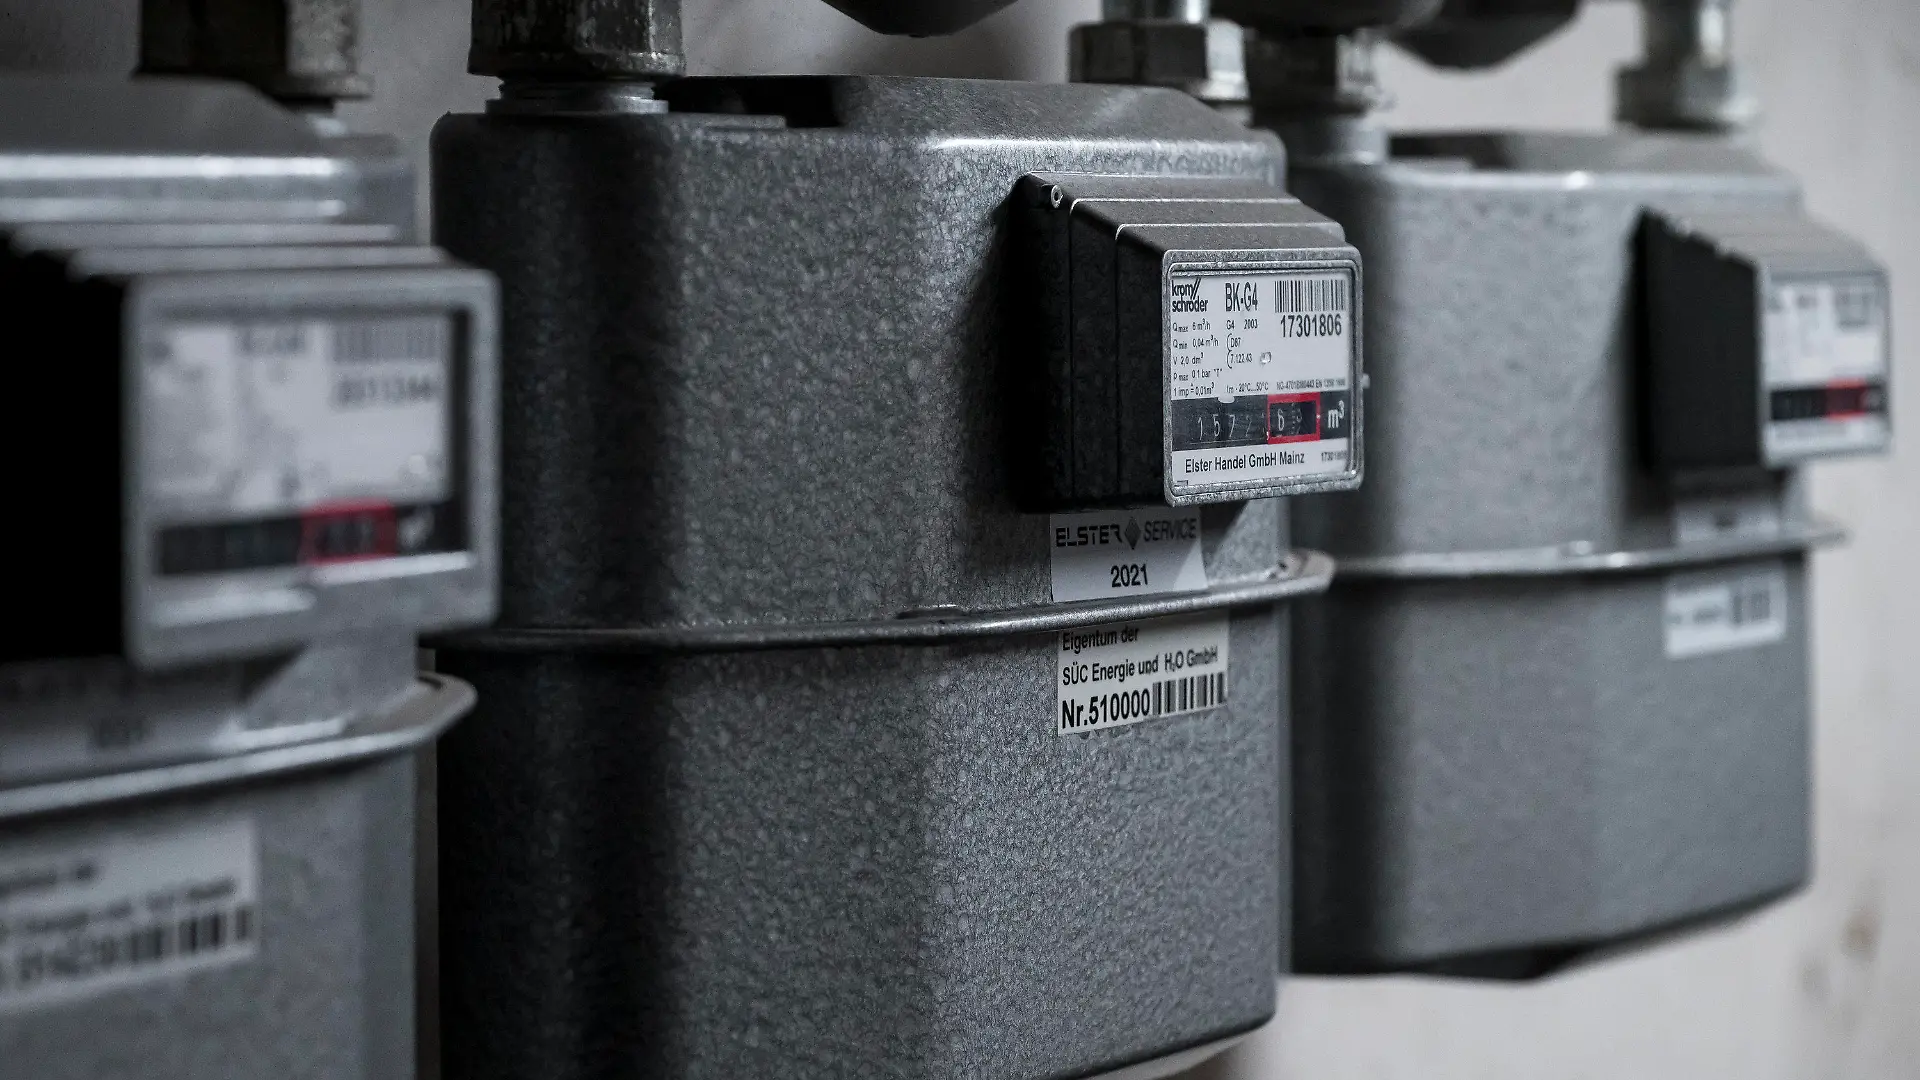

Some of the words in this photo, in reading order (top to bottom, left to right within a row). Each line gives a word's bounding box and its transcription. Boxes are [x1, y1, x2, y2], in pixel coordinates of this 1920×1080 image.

[1225, 282, 1258, 312] BK-G4
[1226, 319, 1235, 330] G4
[1280, 313, 1342, 338] 17301806
[1173, 356, 1178, 366] V
[1201, 368, 1211, 379] bar
[1185, 457, 1213, 474] Elster
[1214, 454, 1247, 471] Handel
[1248, 451, 1278, 469] GmbH
[1279, 451, 1305, 465] Mainz
[1055, 524, 1123, 548] ELSTER
[1143, 517, 1198, 543] SERVICE
[1110, 563, 1149, 588] 2021
[1062, 629, 1118, 655] Eigentum
[1120, 625, 1140, 644] der
[1062, 661, 1089, 686] SÜC
[1092, 658, 1136, 683] Energie
[1138, 655, 1159, 675] und
[1186, 645, 1219, 668] GmbH
[1062, 687, 1150, 730] Nr.510000
